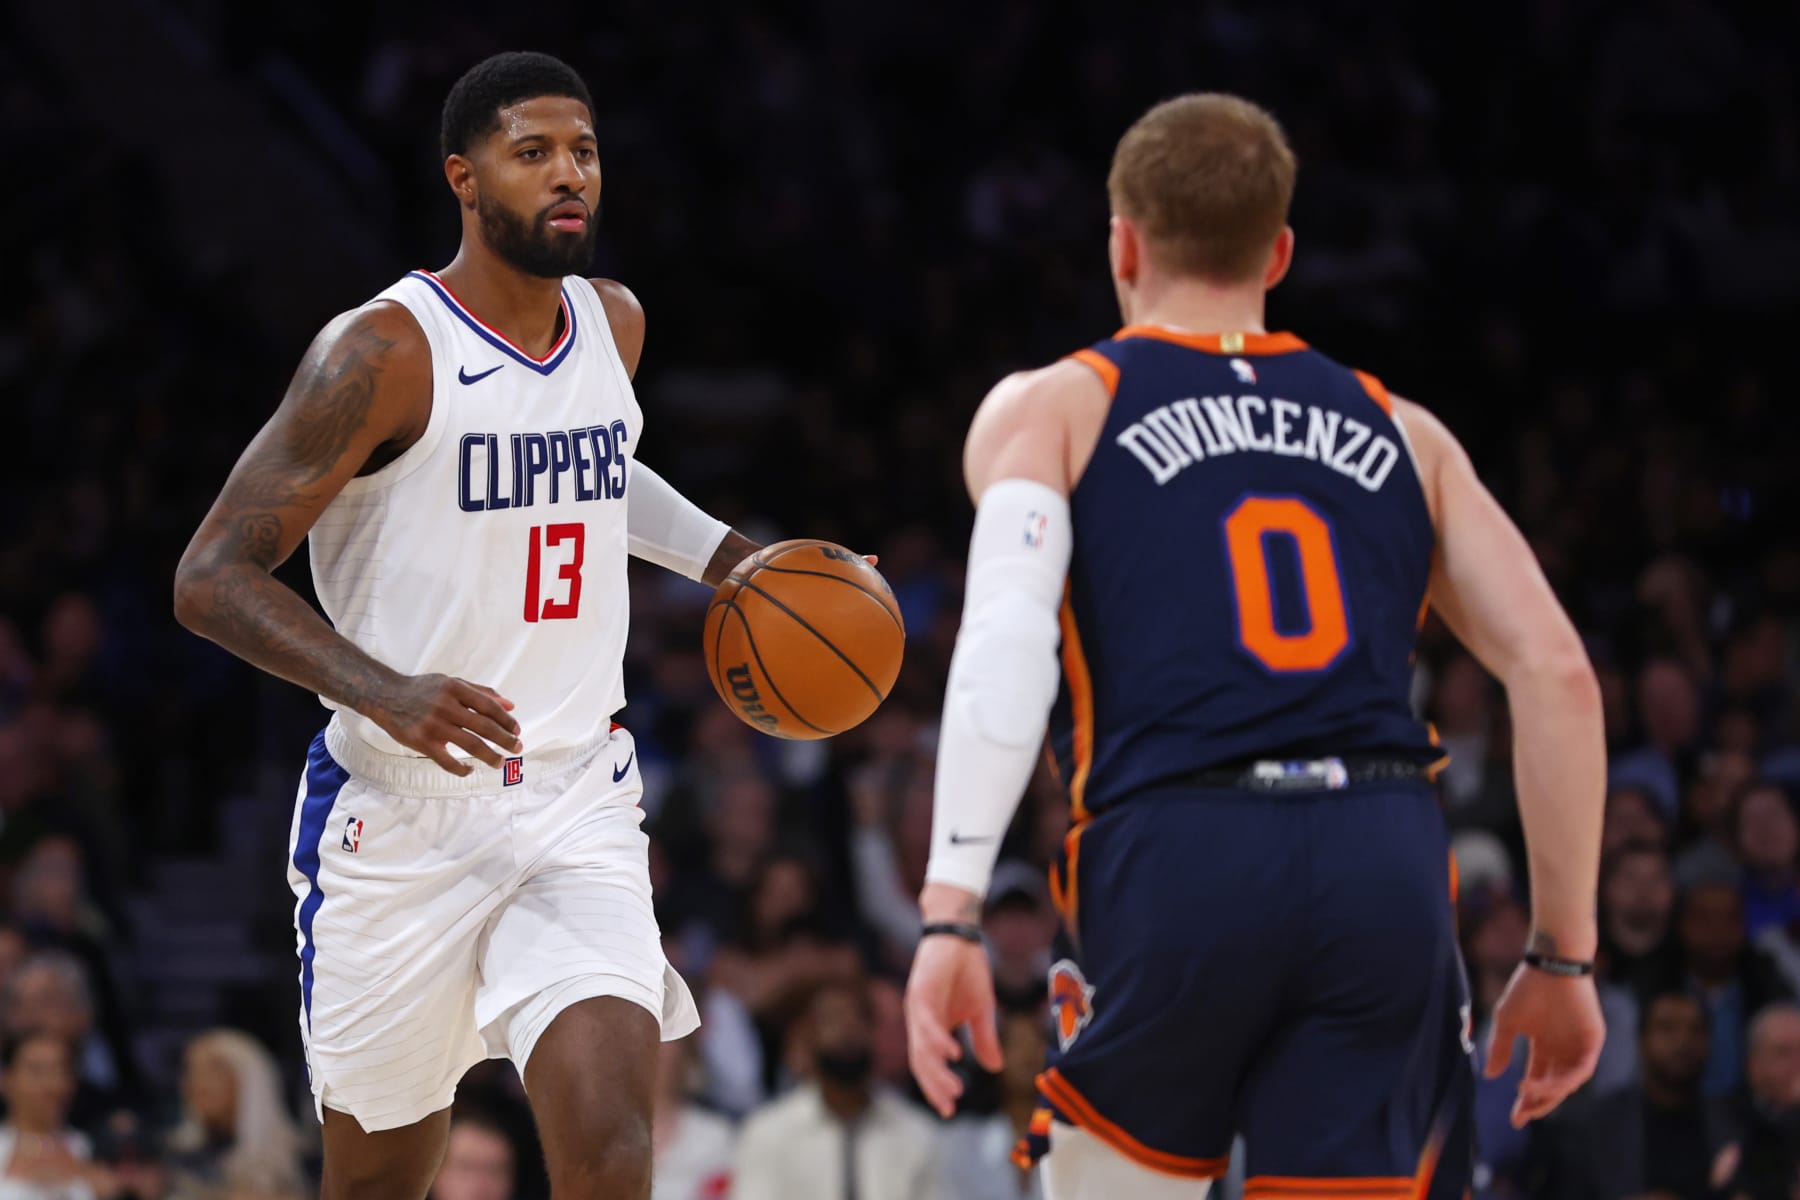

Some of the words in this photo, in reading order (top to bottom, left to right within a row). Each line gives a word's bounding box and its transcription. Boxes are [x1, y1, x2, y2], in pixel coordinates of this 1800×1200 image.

[458, 419, 627, 512] CLIPPERS
[1116, 395, 1399, 493] DIVINCENZO
[523, 522, 585, 623] 13
[1220, 492, 1354, 675] 0
[726, 661, 780, 734] Wil
